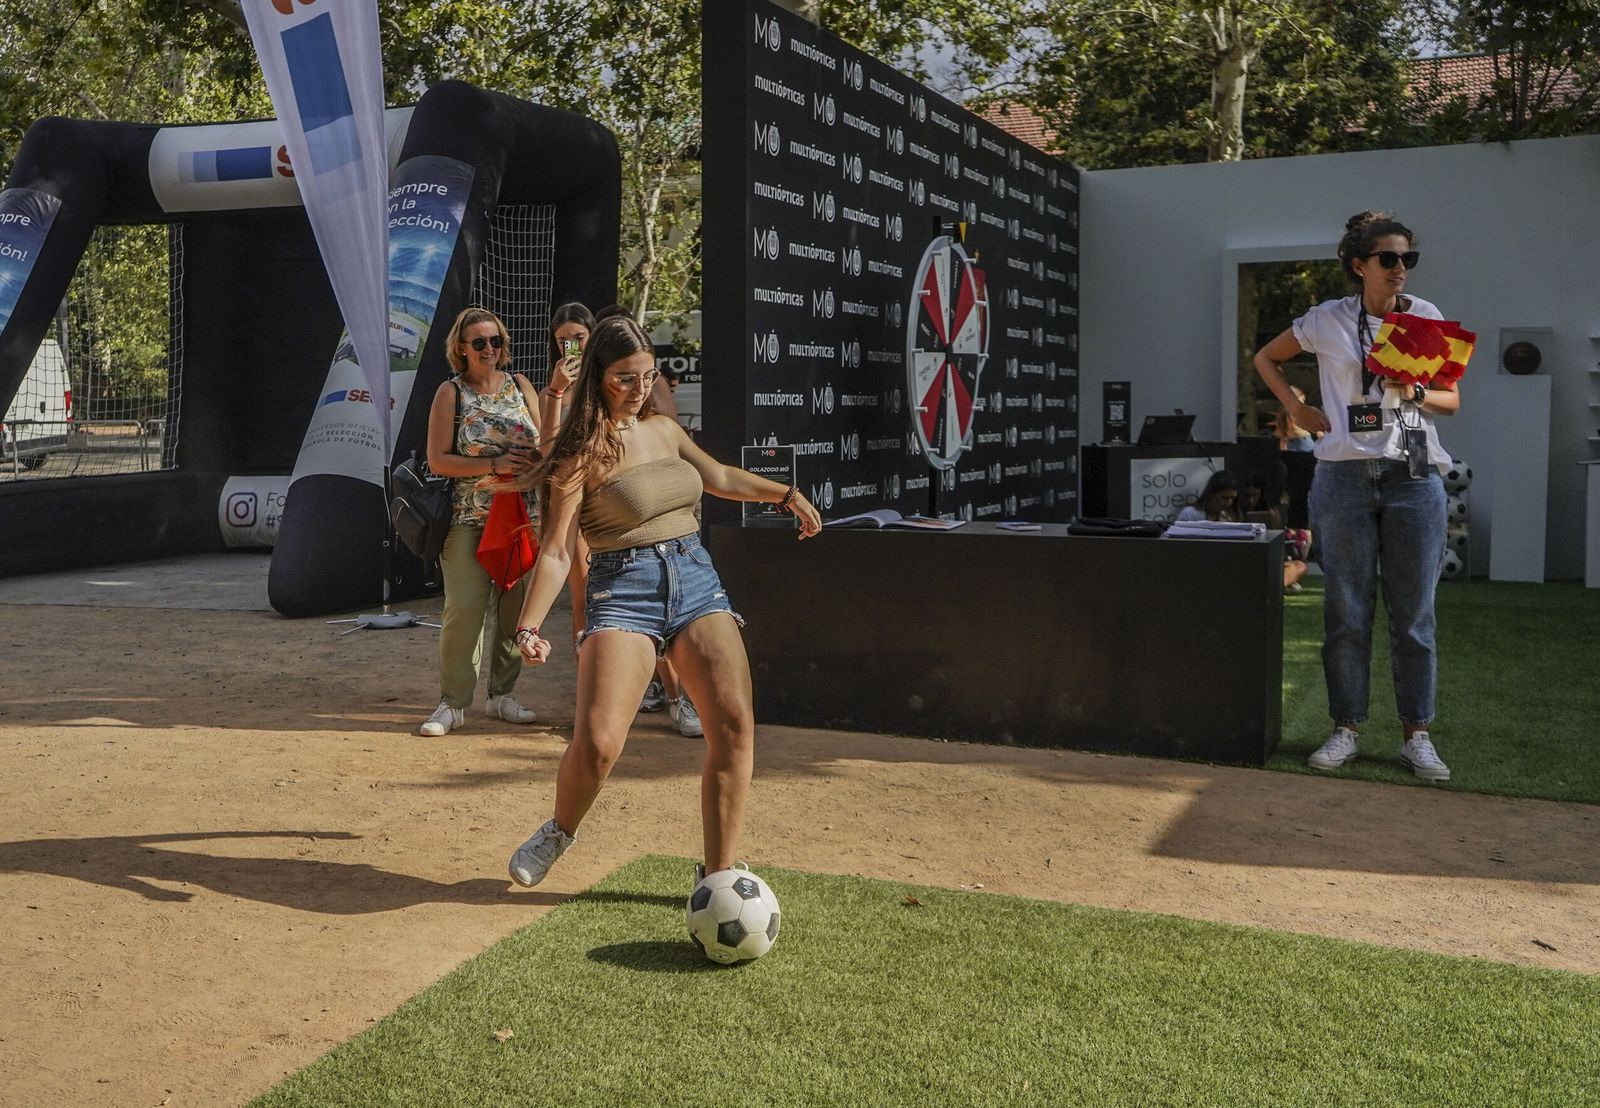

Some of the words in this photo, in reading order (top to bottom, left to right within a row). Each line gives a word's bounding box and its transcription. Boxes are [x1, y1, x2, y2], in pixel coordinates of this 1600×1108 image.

[402, 199, 416, 210] la
[388, 214, 450, 234] ección!
[1142, 470, 1187, 489] solo
[1143, 488, 1199, 512] pued
